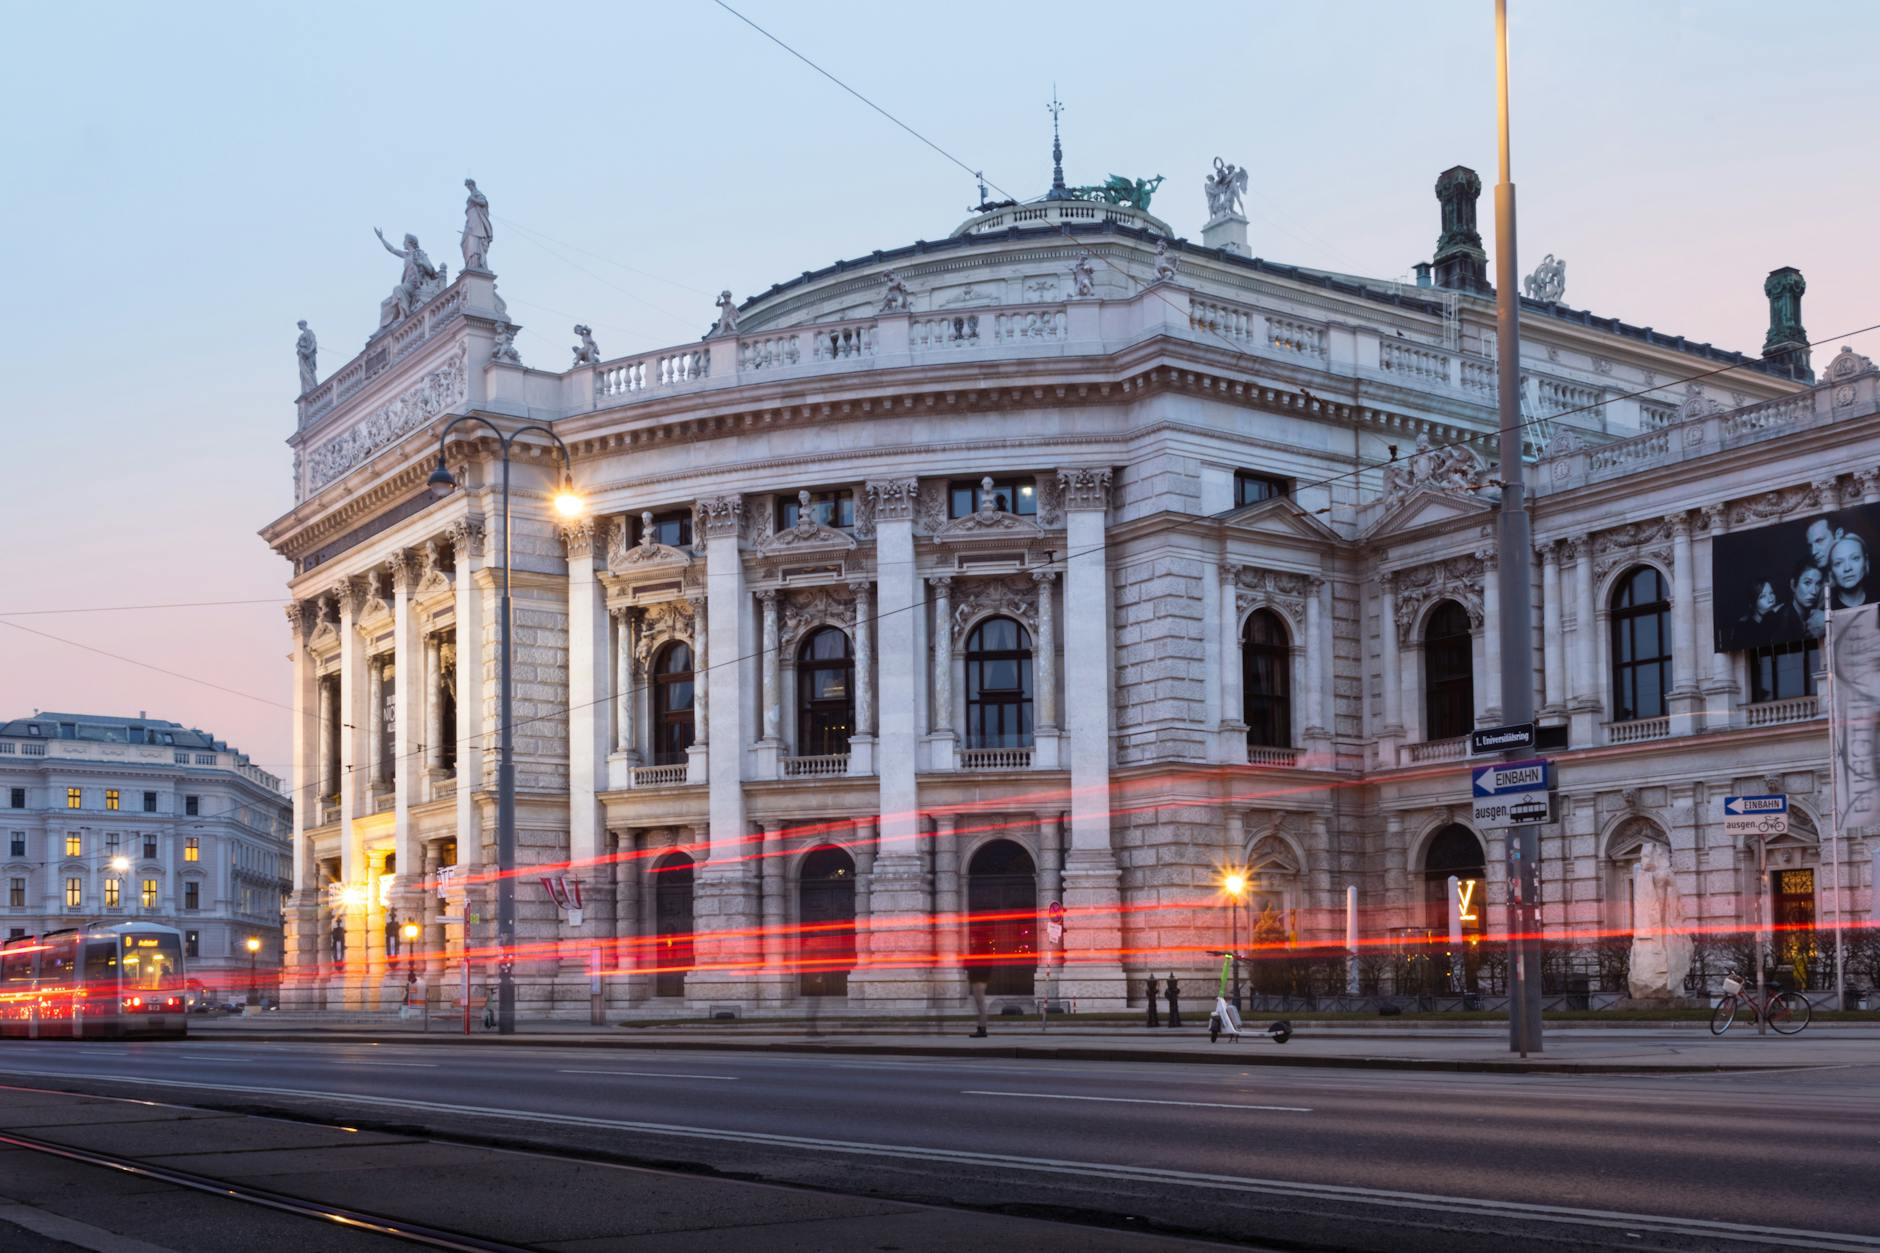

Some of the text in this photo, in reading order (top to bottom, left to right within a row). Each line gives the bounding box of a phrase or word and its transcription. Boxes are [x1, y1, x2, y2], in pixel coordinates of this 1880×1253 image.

[1483, 731, 1530, 745] Universitätsring
[1495, 768, 1539, 786] EINBAHN
[1744, 800, 1780, 809] EINBAHN
[1475, 806, 1510, 821] ausgen.
[1726, 821, 1759, 831] ausgen.
